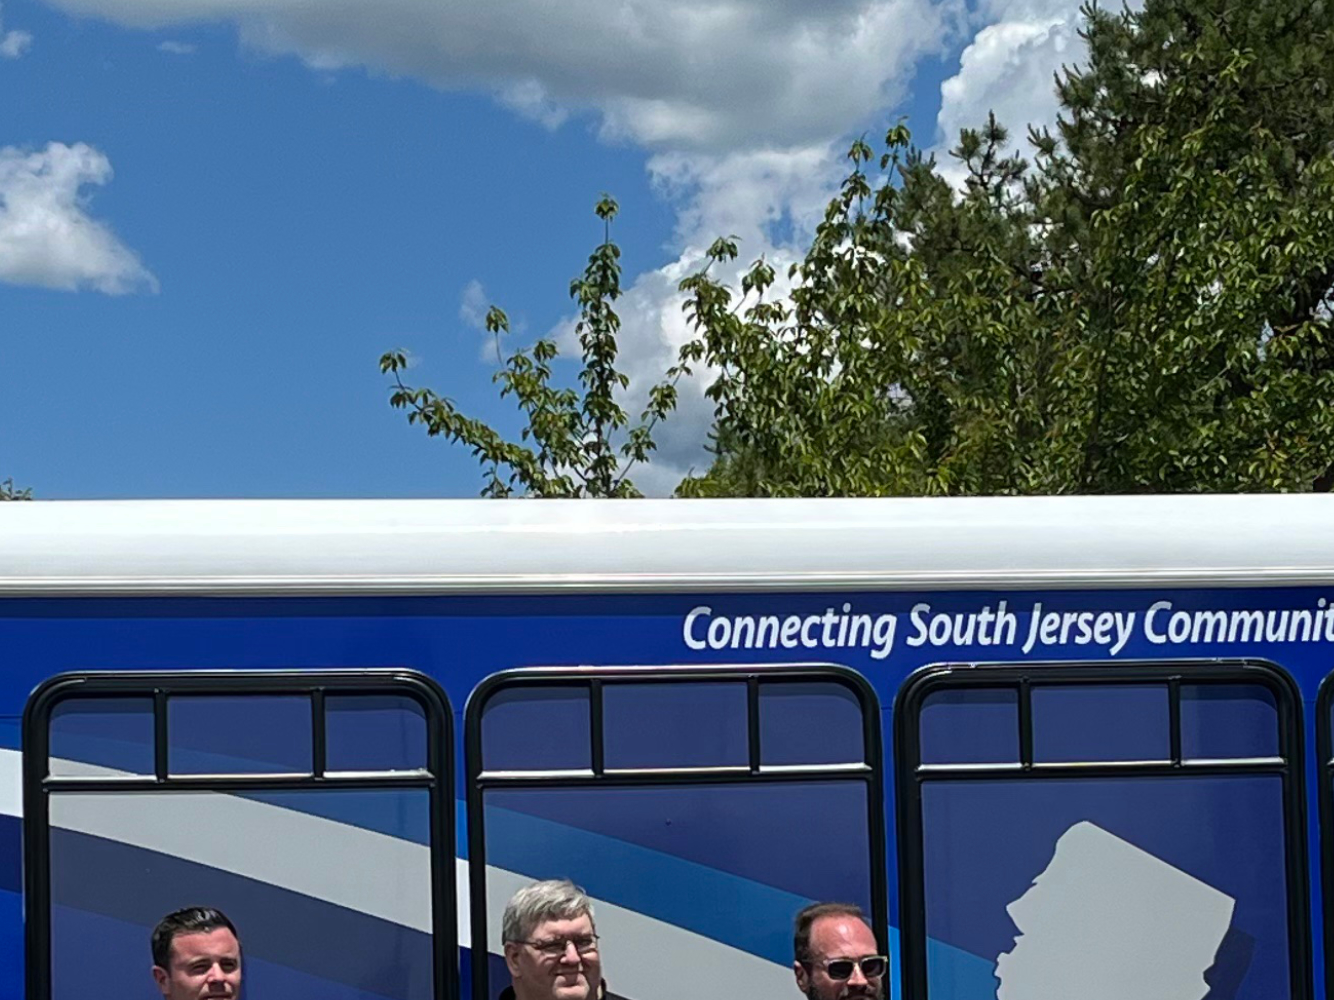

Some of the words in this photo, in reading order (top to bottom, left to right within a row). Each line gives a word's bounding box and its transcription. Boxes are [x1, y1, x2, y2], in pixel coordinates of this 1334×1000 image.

[683, 602, 898, 660] Connecting
[906, 600, 1017, 648] South
[1021, 602, 1136, 657] Jersey
